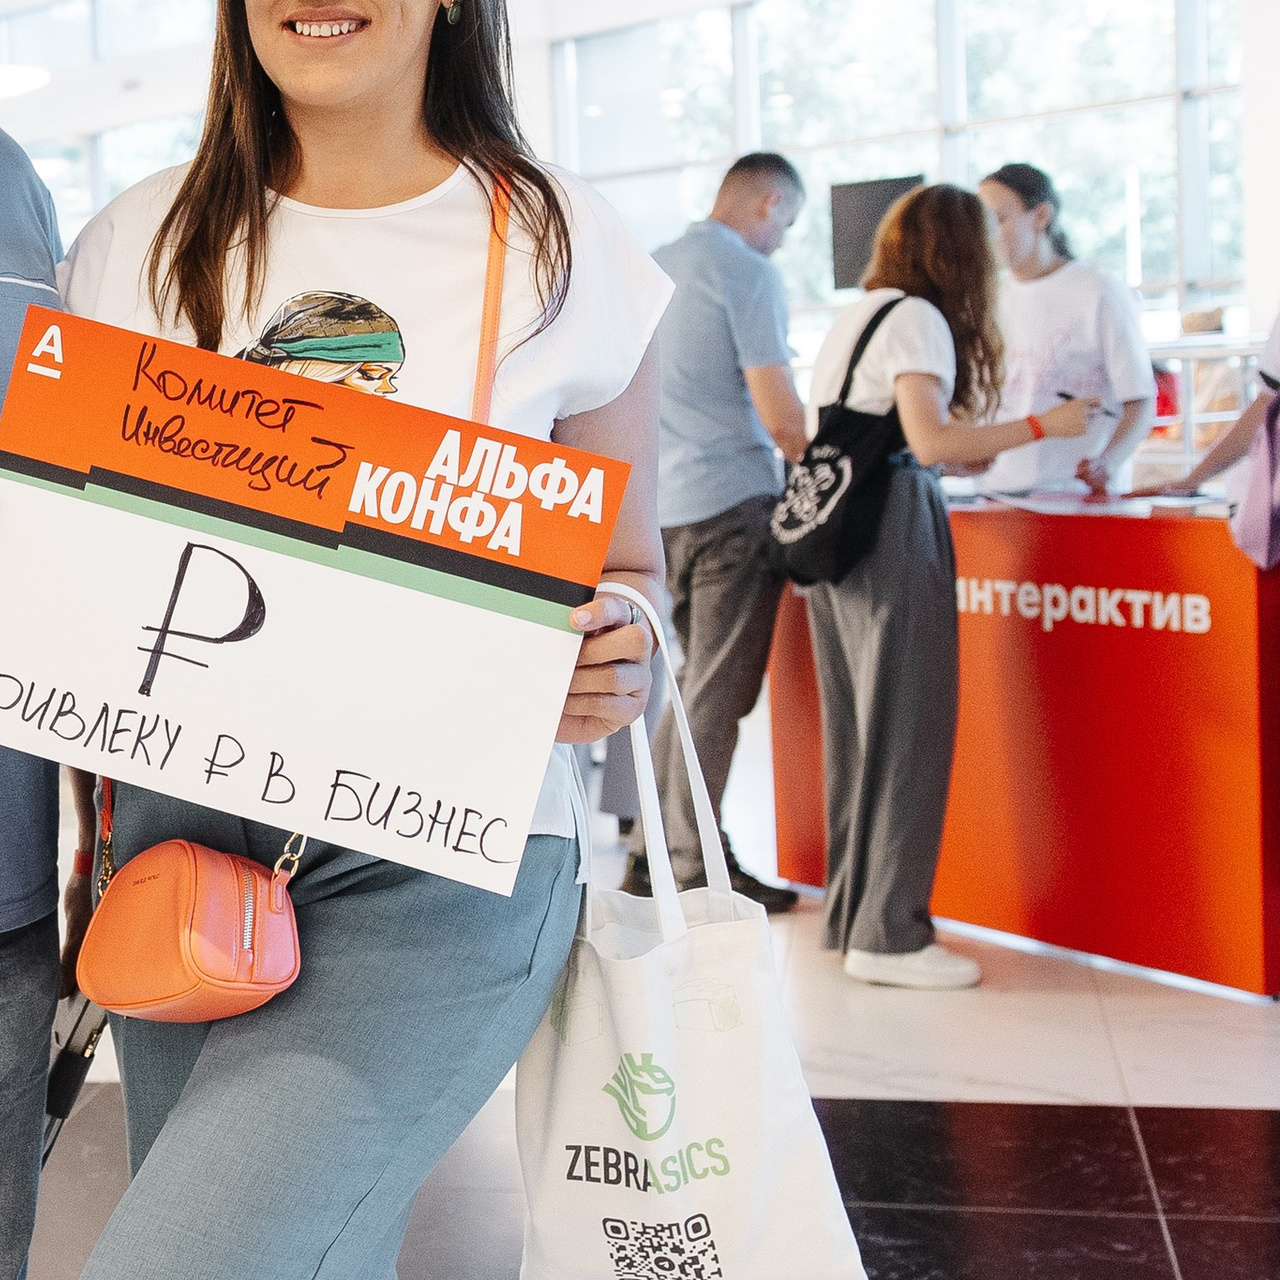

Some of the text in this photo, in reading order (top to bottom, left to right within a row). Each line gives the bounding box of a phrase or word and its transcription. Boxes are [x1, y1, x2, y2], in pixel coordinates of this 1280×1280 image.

[132, 341, 325, 433] Комитет
[121, 403, 356, 500] Инвестиций
[424, 428, 605, 524] АЛЬФА
[347, 460, 523, 557] КОНФА
[261, 751, 296, 804] В
[323, 769, 519, 864] БИЗНЕС
[565, 1137, 730, 1195] ZEBRASICS
